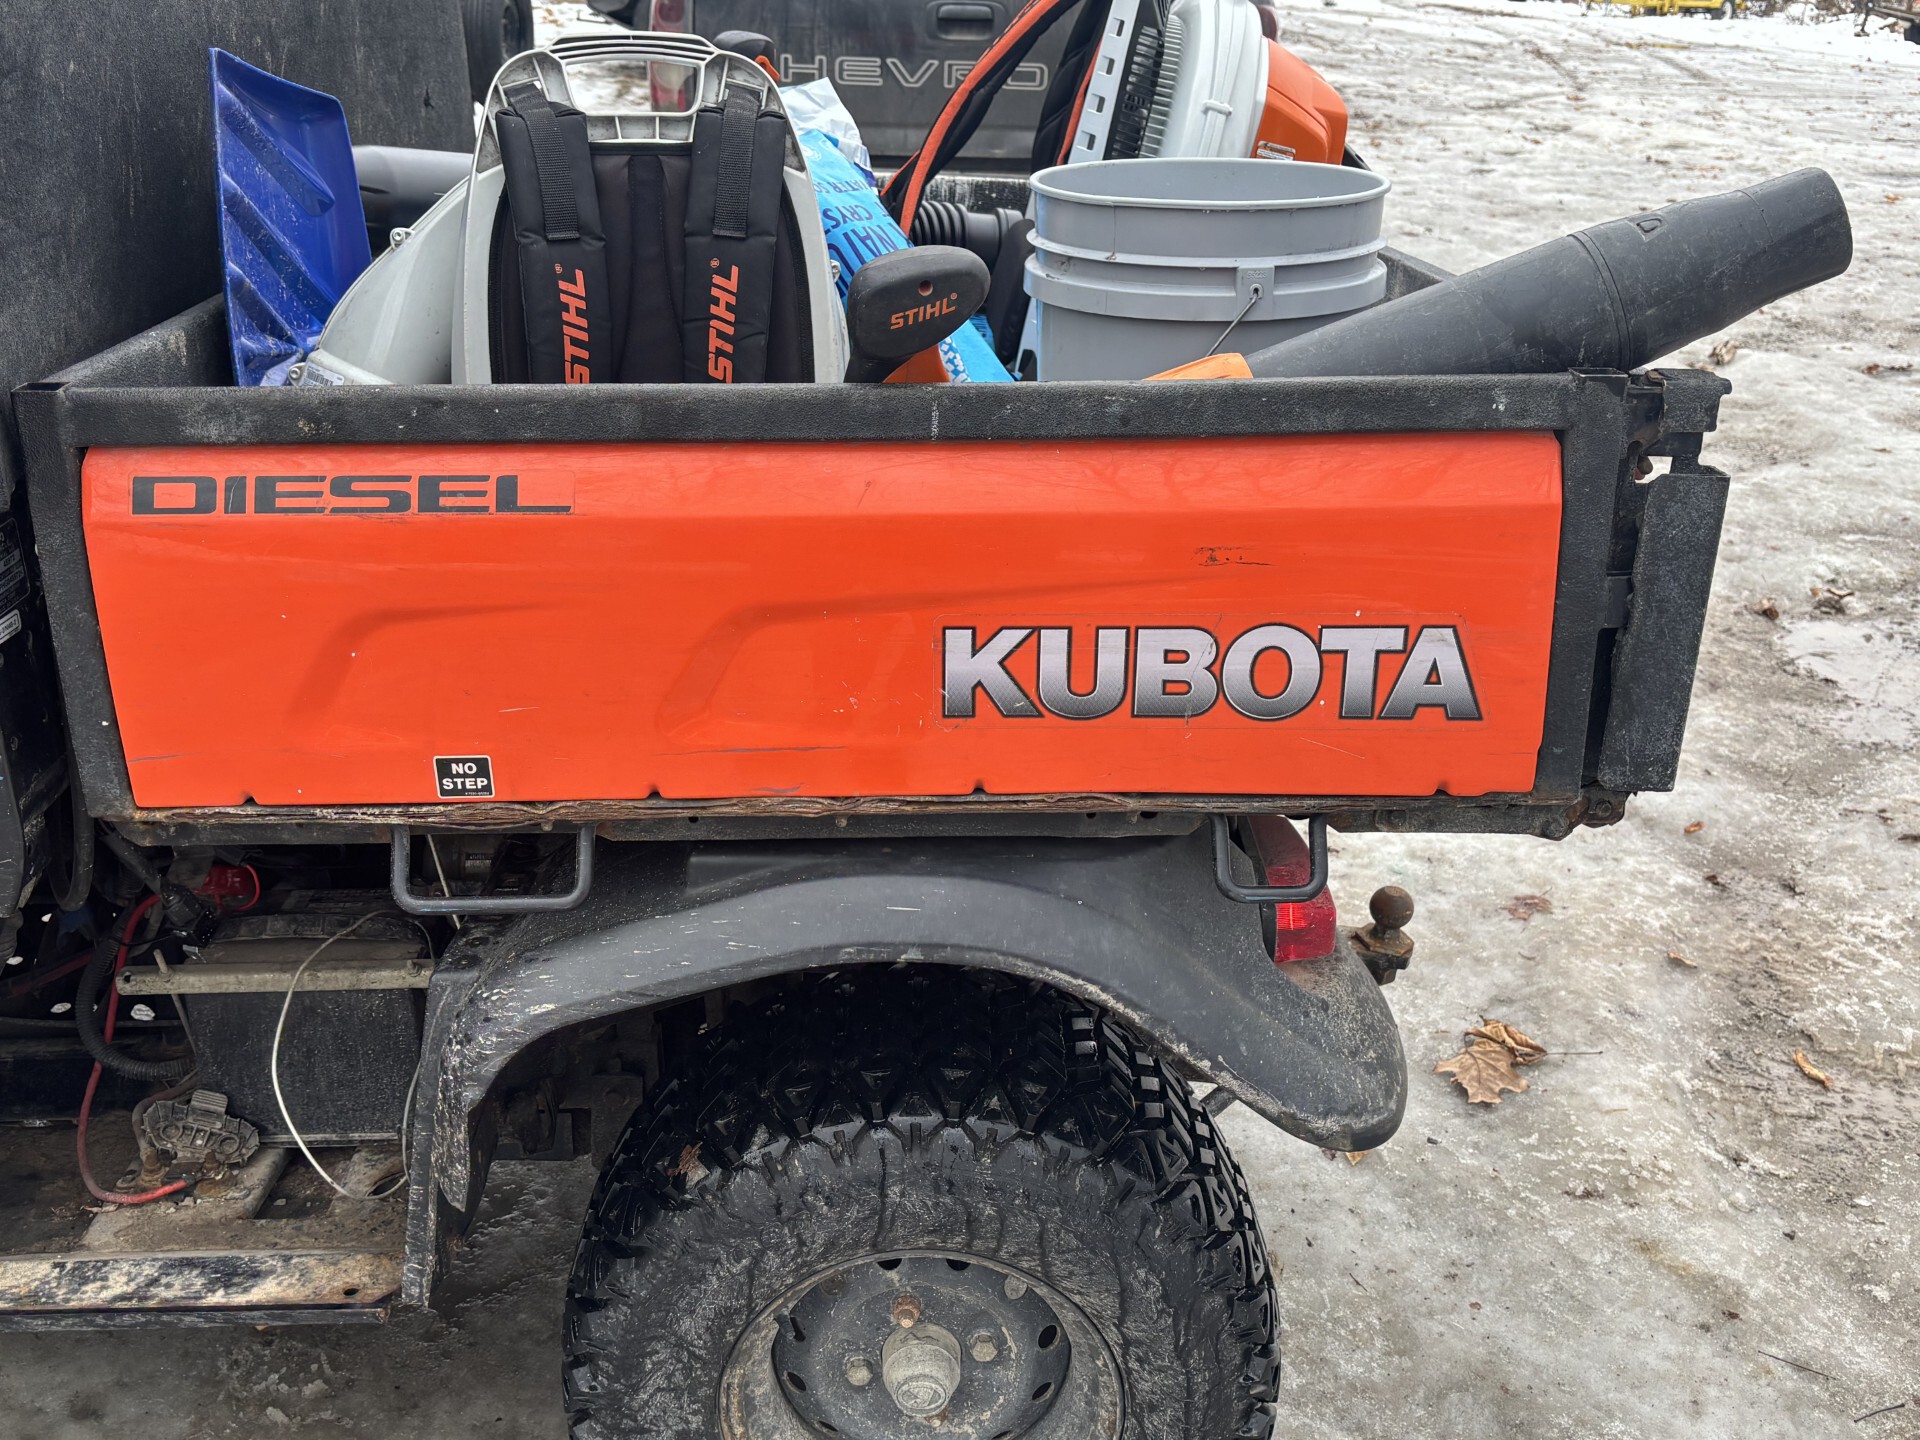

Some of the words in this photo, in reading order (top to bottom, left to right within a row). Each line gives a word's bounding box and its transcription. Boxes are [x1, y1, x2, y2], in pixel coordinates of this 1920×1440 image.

[779, 53, 1049, 91] HEVRO
[823, 204, 873, 234] CRYS
[558, 268, 590, 384] STIHL
[708, 264, 739, 384] STIHL
[890, 297, 956, 330] STIHL
[132, 474, 572, 515] DIESEL
[942, 622, 1483, 721] KUBOTA
[442, 777, 488, 790] STEP
[451, 762, 477, 775] NO
